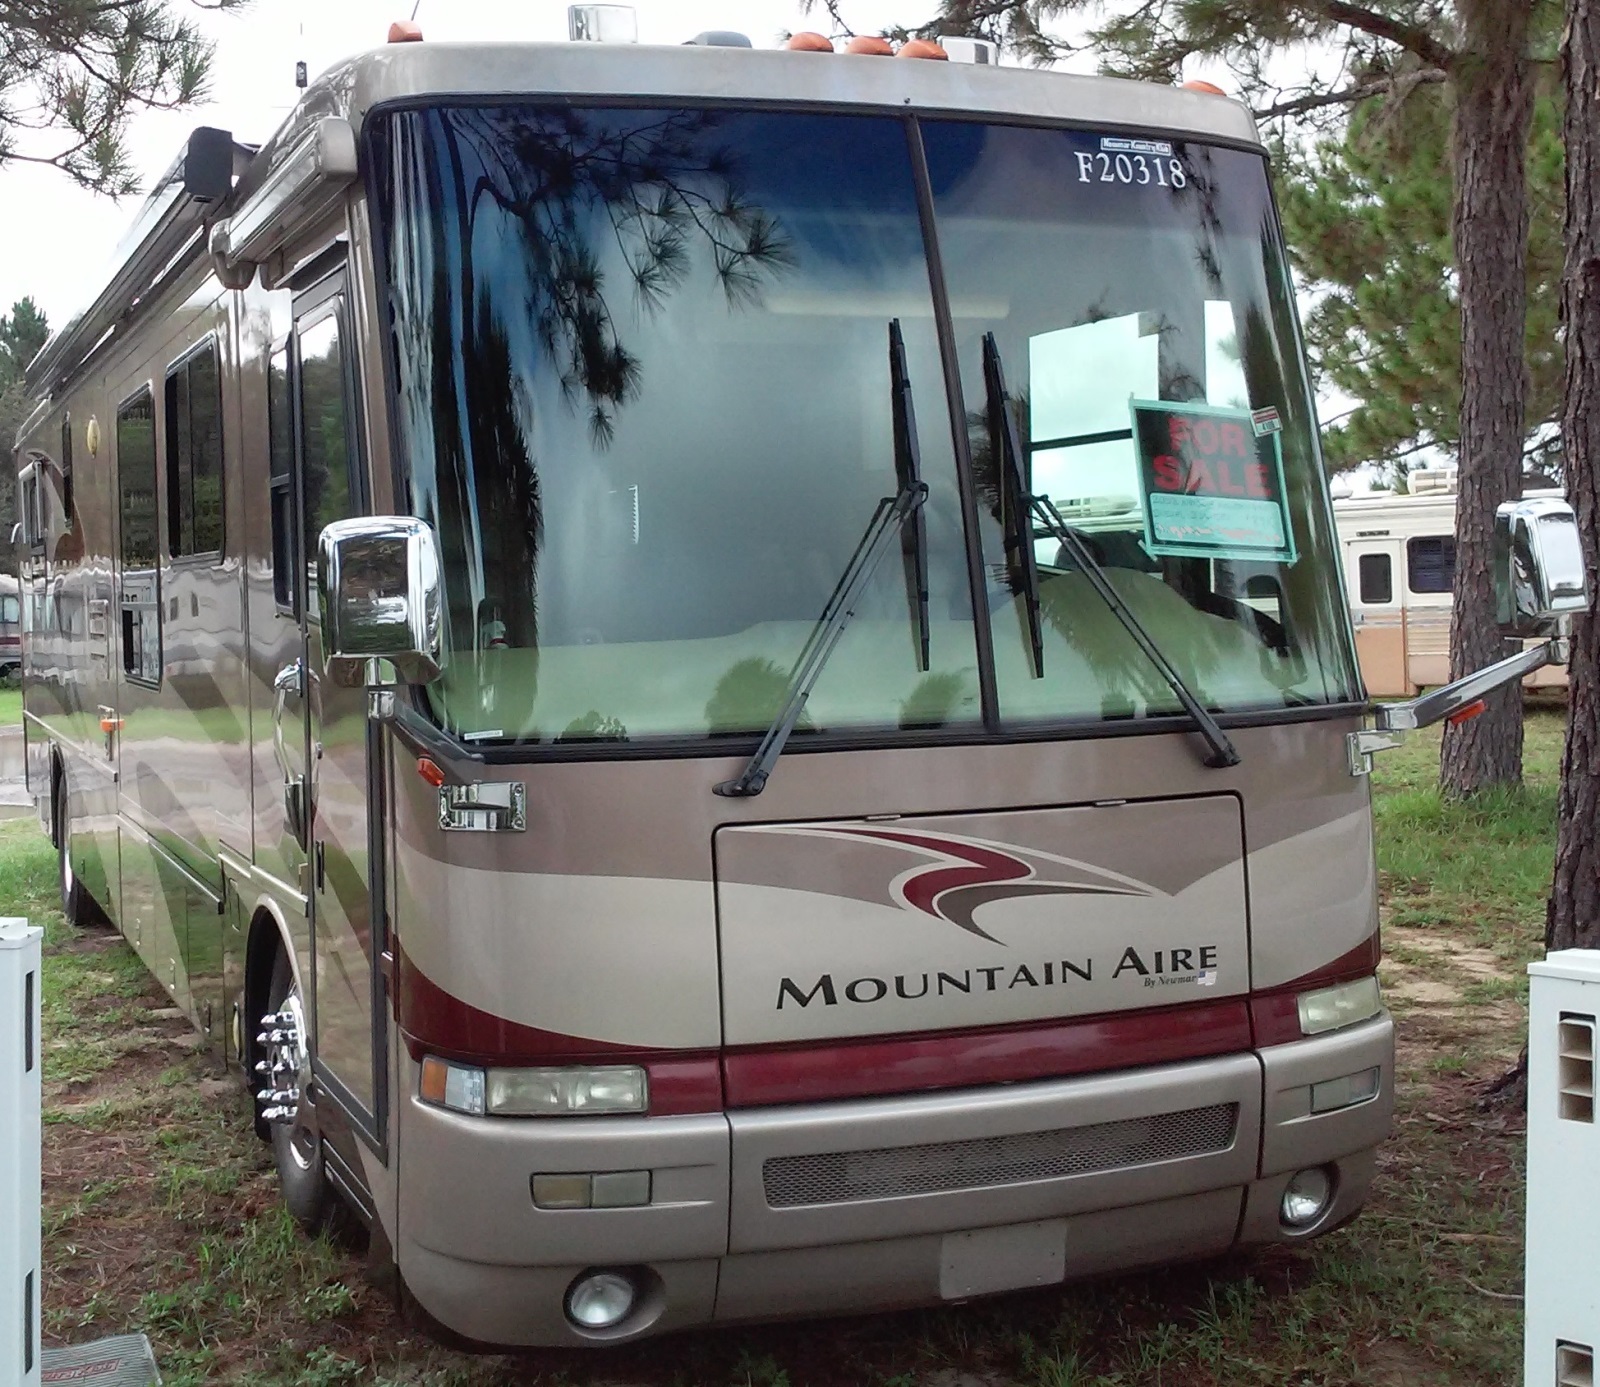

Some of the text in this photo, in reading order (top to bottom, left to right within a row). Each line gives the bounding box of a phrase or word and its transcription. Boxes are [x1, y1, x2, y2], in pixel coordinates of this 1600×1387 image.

[1074, 151, 1186, 188] F20318
[1168, 416, 1247, 457] FOR
[1153, 454, 1273, 497] SALE
[776, 945, 1218, 1010] MOUNTAIN AIRE
[1144, 975, 1198, 989] By Newmar
